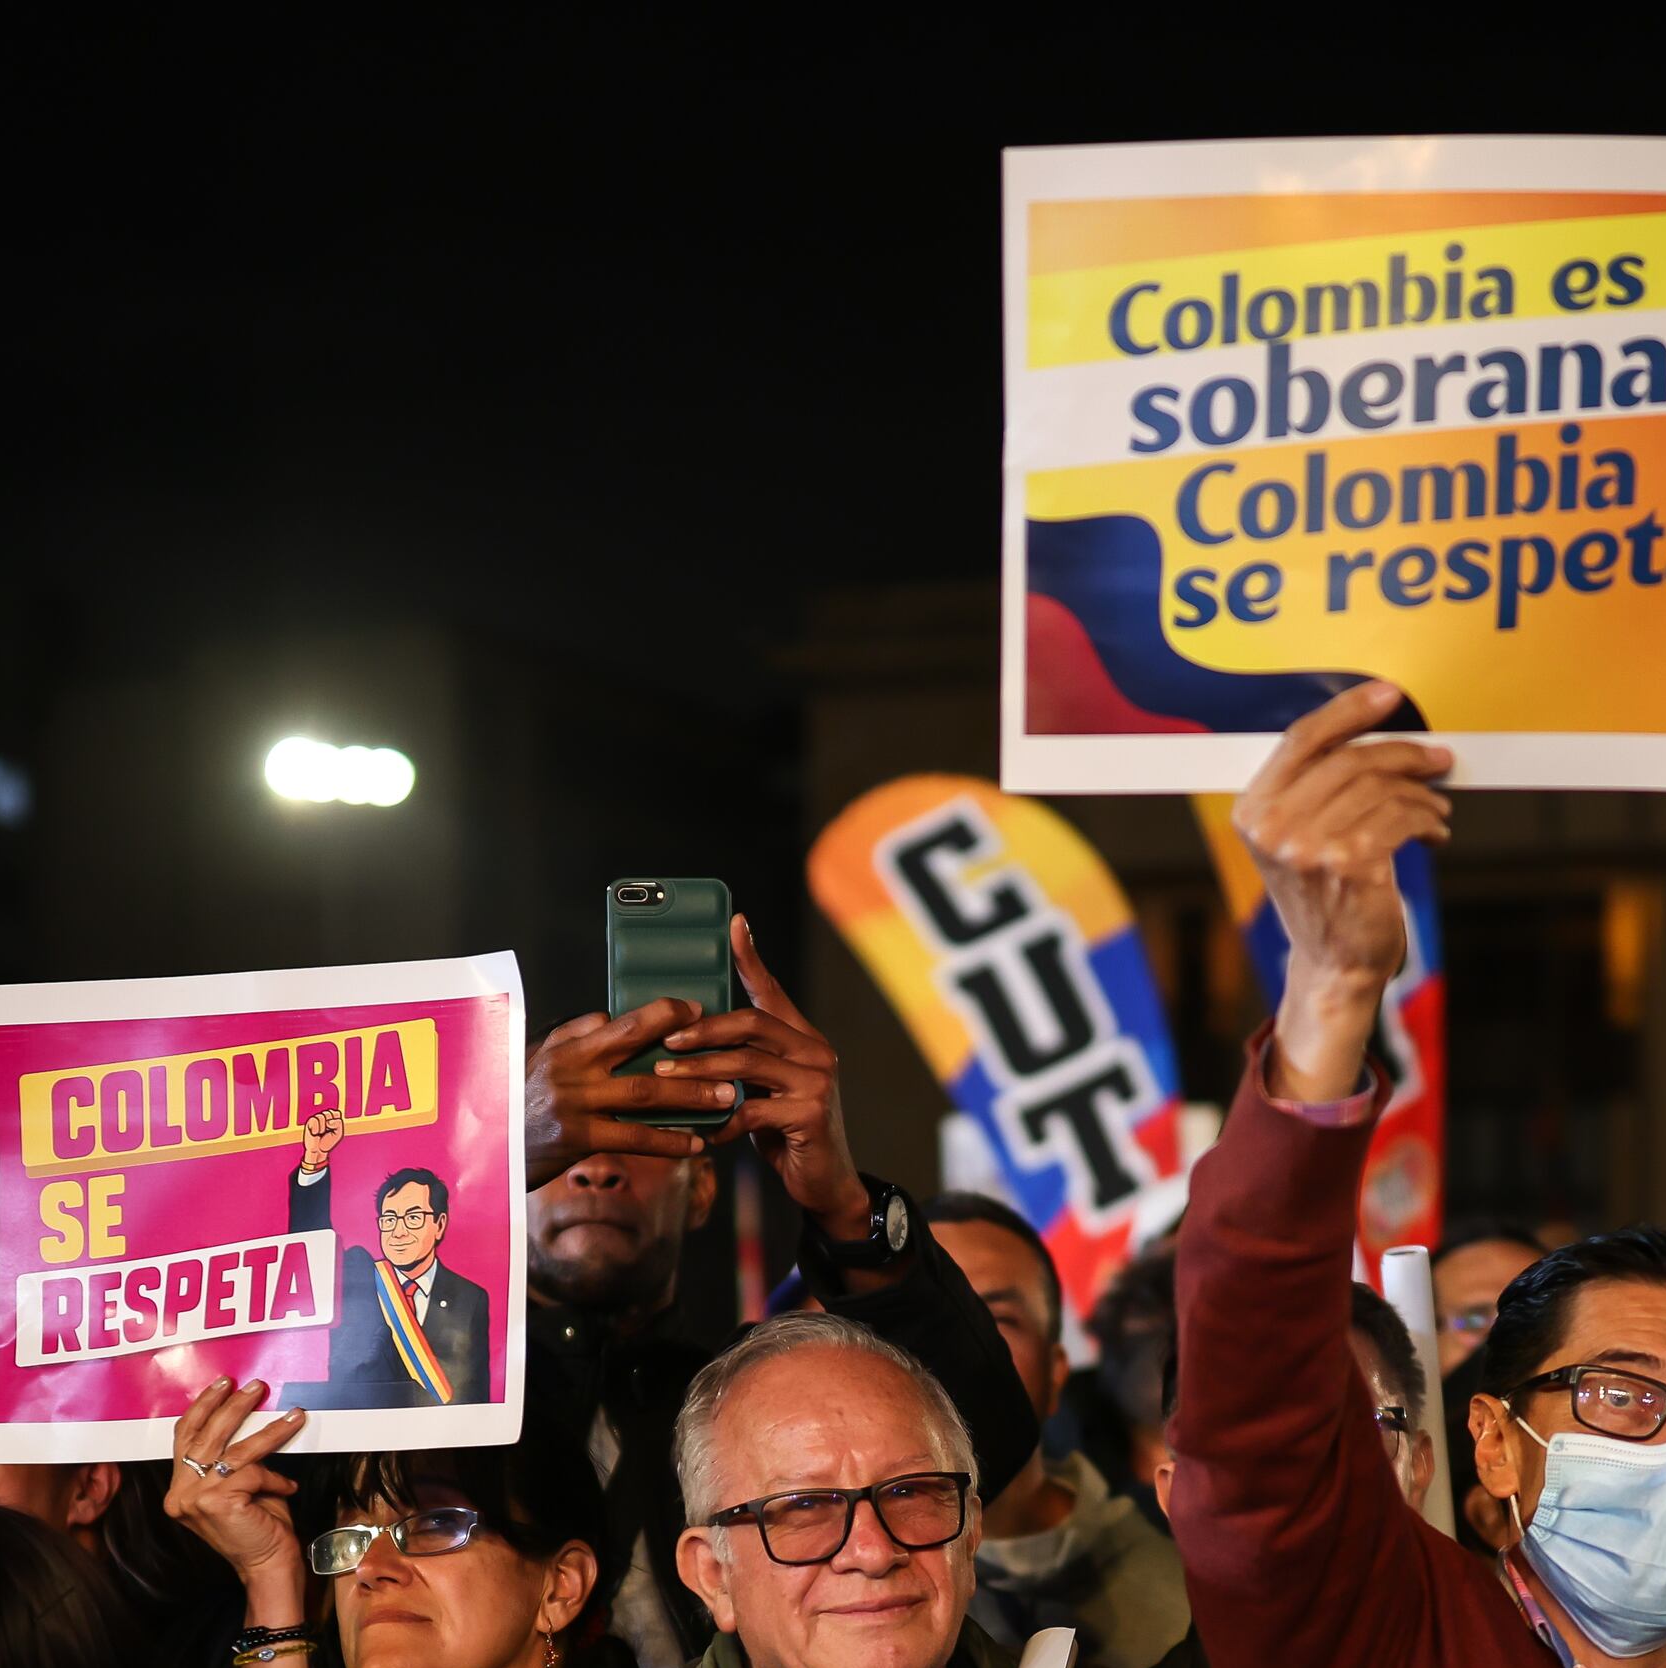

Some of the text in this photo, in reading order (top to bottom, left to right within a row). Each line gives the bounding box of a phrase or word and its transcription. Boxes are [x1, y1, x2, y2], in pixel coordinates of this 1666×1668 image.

[1106, 242, 1647, 358] Colombia es
[1174, 422, 1637, 548] Colombia
[1171, 556, 1284, 633] se
[889, 813, 1141, 1213] CUT
[50, 1029, 413, 1161] COLOMBIA
[38, 1173, 127, 1265] SE
[40, 1241, 316, 1356] RESPETA
